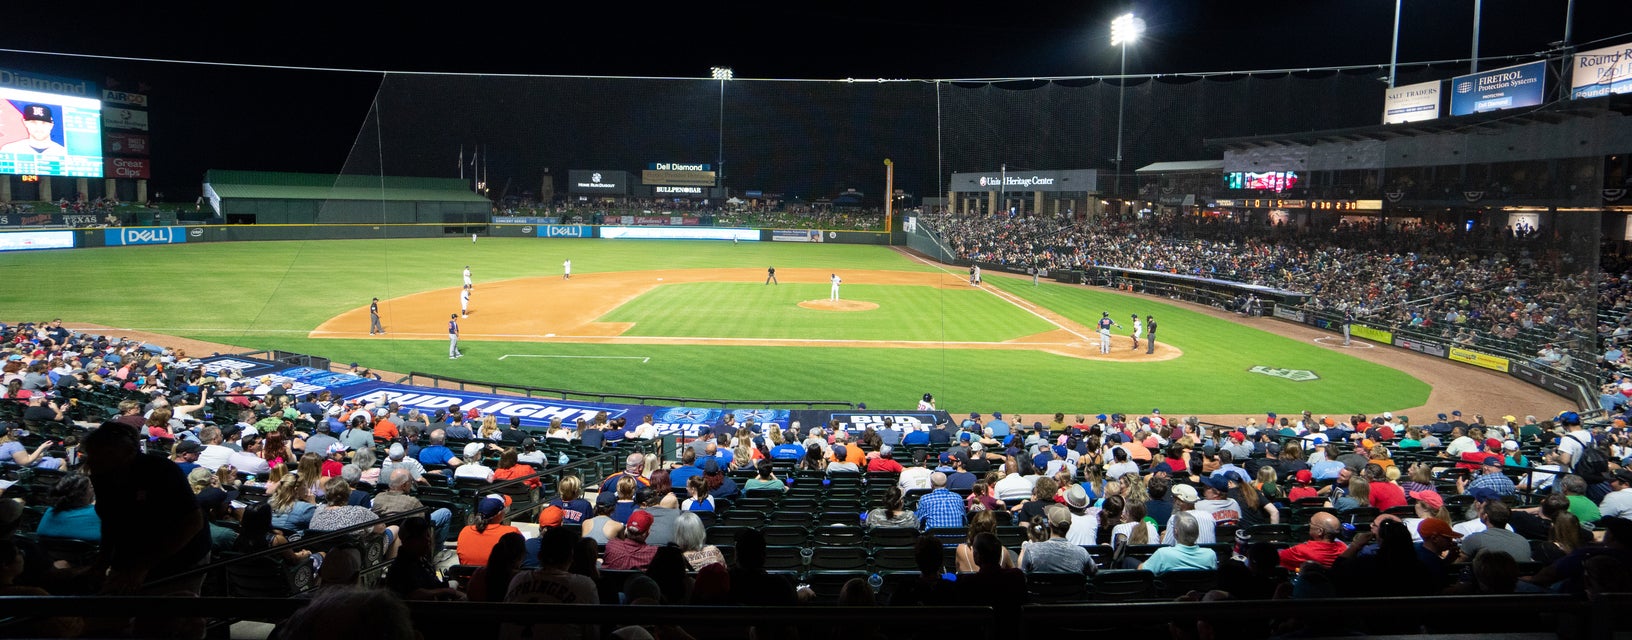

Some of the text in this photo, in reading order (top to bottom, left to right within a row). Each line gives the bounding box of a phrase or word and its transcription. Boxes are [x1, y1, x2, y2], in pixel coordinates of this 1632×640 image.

[1580, 51, 1619, 68] Round
[0, 71, 86, 95] Diamond
[1479, 70, 1523, 86] FIRETROL
[1478, 77, 1537, 92] Protection Systems
[1406, 88, 1437, 98] TRADERS
[113, 158, 143, 168] Great
[656, 163, 703, 171] Dell Diamond
[116, 167, 141, 178] Clips
[1007, 177, 1032, 188] Heritage
[1032, 176, 1054, 185] Center
[63, 216, 97, 225] TEXAS
[128, 229, 167, 243] DELL
[552, 226, 578, 236] DELL
[357, 391, 613, 423] BUD LIGHT
[851, 415, 919, 424] BUD
[563, 509, 583, 522] UVE
